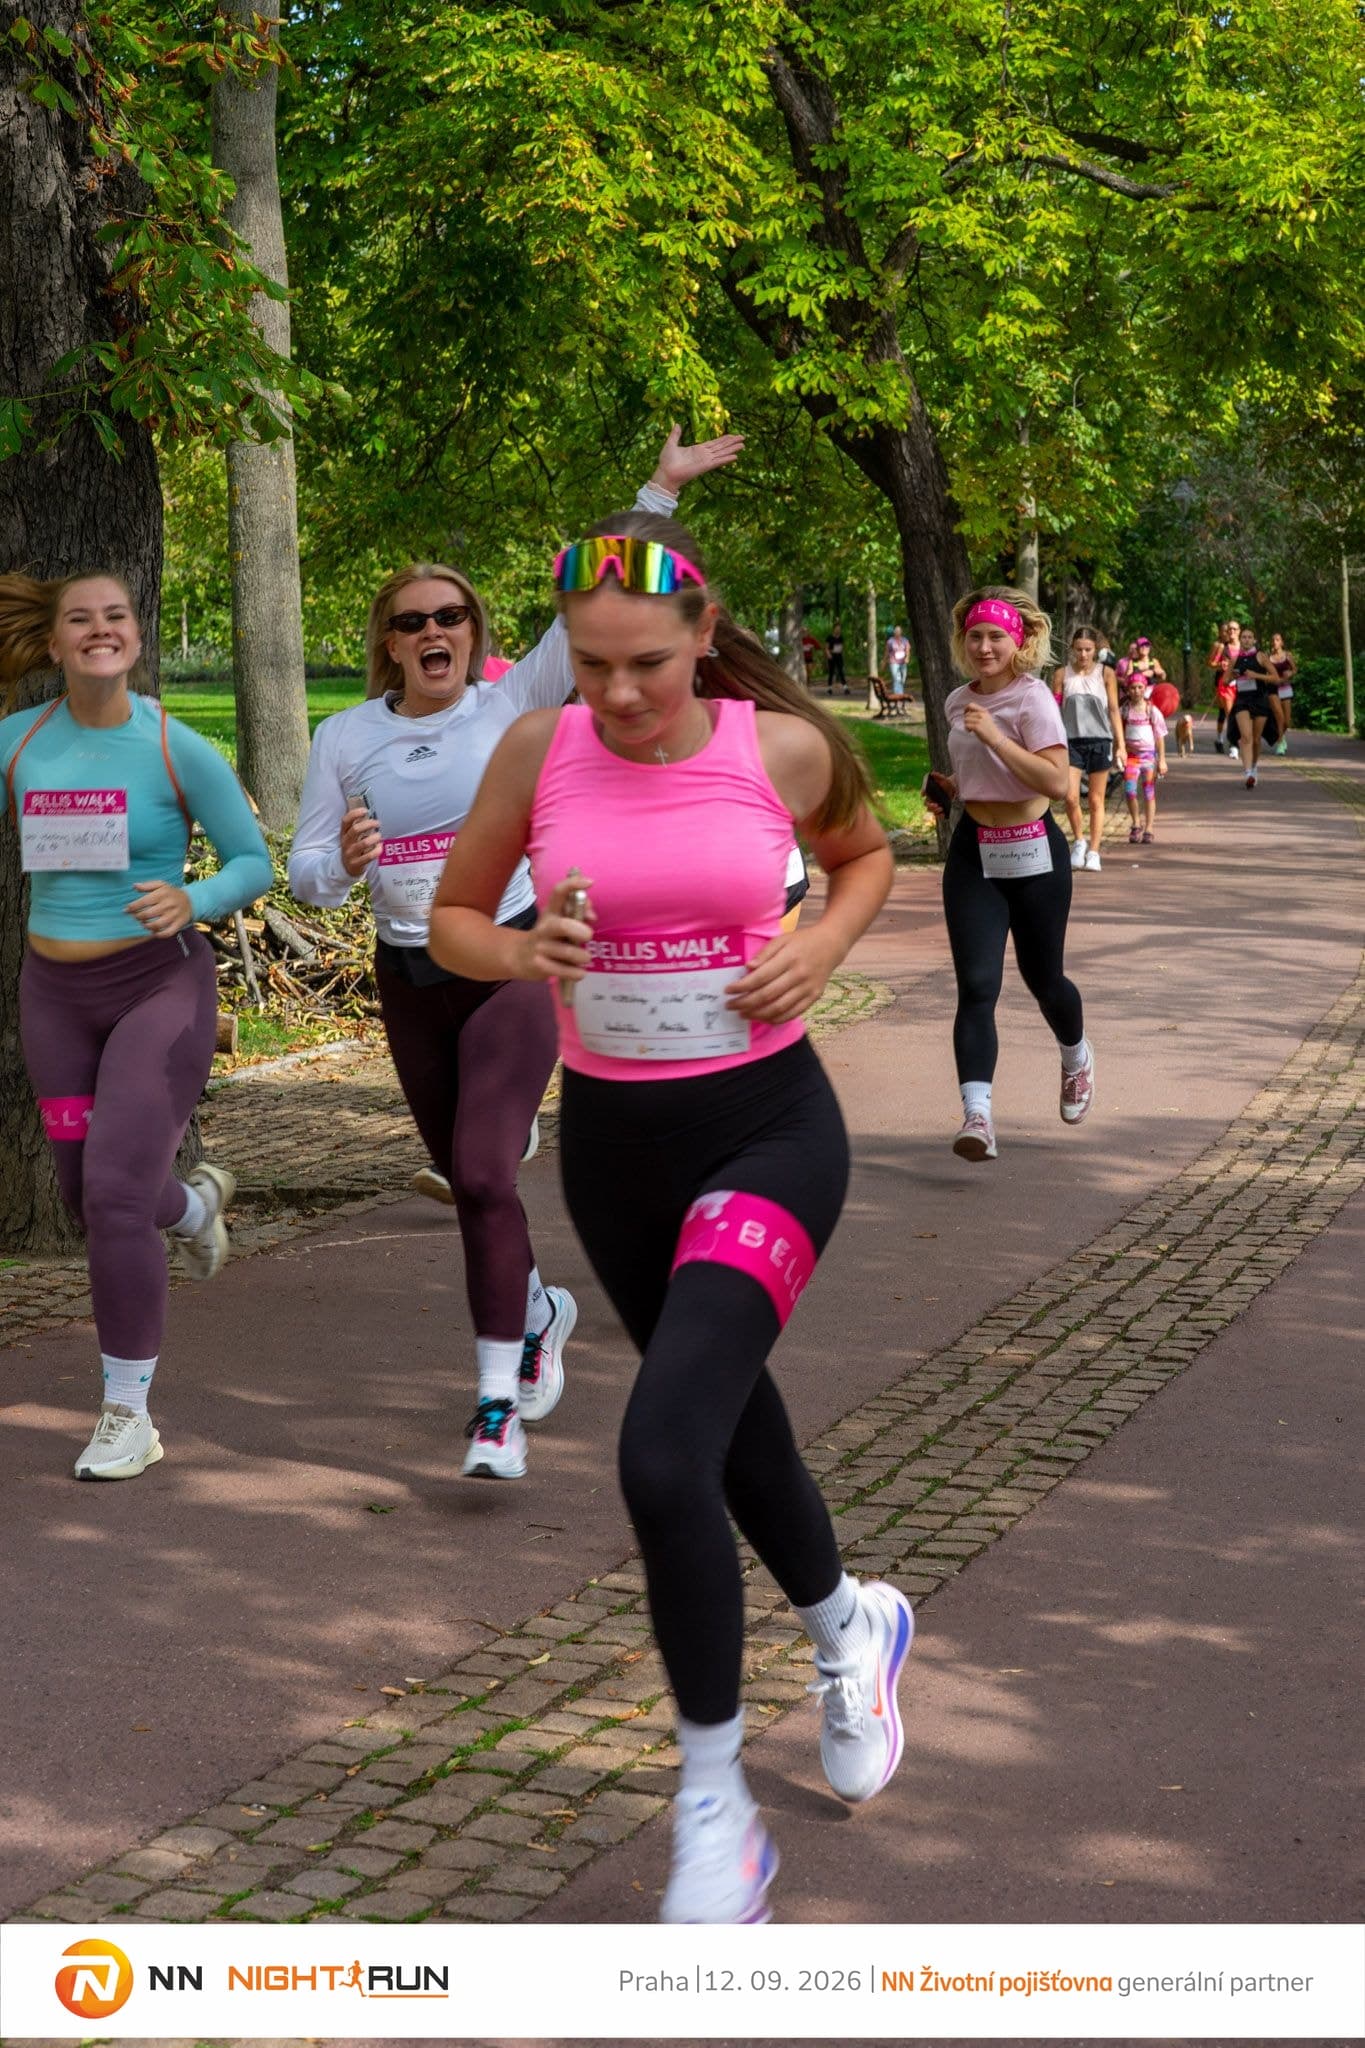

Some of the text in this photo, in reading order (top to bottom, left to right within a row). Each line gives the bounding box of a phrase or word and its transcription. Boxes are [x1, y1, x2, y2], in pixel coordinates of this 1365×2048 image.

[31, 792, 117, 808] BELLIS WALK
[983, 830, 1011, 839] BELLIS
[1013, 824, 1040, 836] WALK
[384, 839, 431, 856] BELLIS
[585, 935, 730, 961] BELLIS WALK
